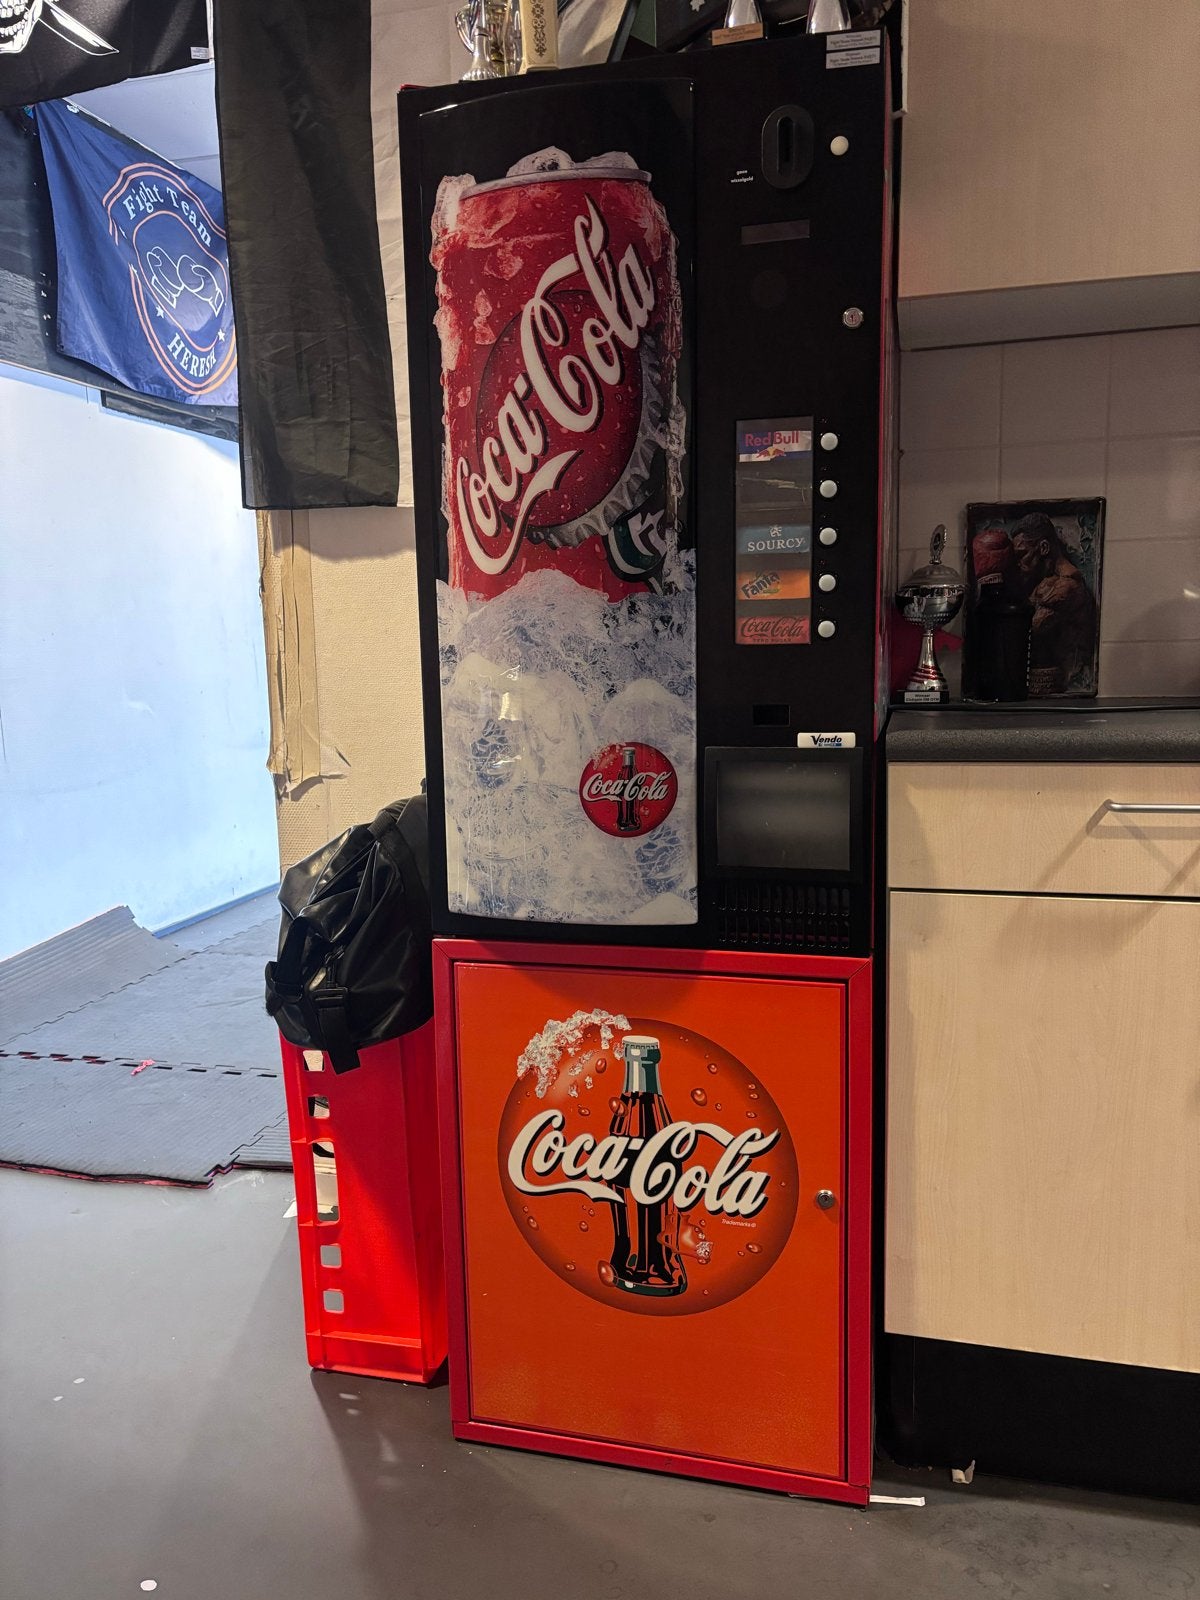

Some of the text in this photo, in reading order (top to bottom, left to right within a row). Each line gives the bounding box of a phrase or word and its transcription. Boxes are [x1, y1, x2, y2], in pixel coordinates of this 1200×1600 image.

[123, 181, 212, 248] Fight Team
[166, 333, 217, 378] HERESH
[744, 430, 800, 447] Red Bull
[747, 537, 805, 552] SOURCY
[741, 571, 782, 599] Fanta
[810, 733, 843, 745] Vendo
